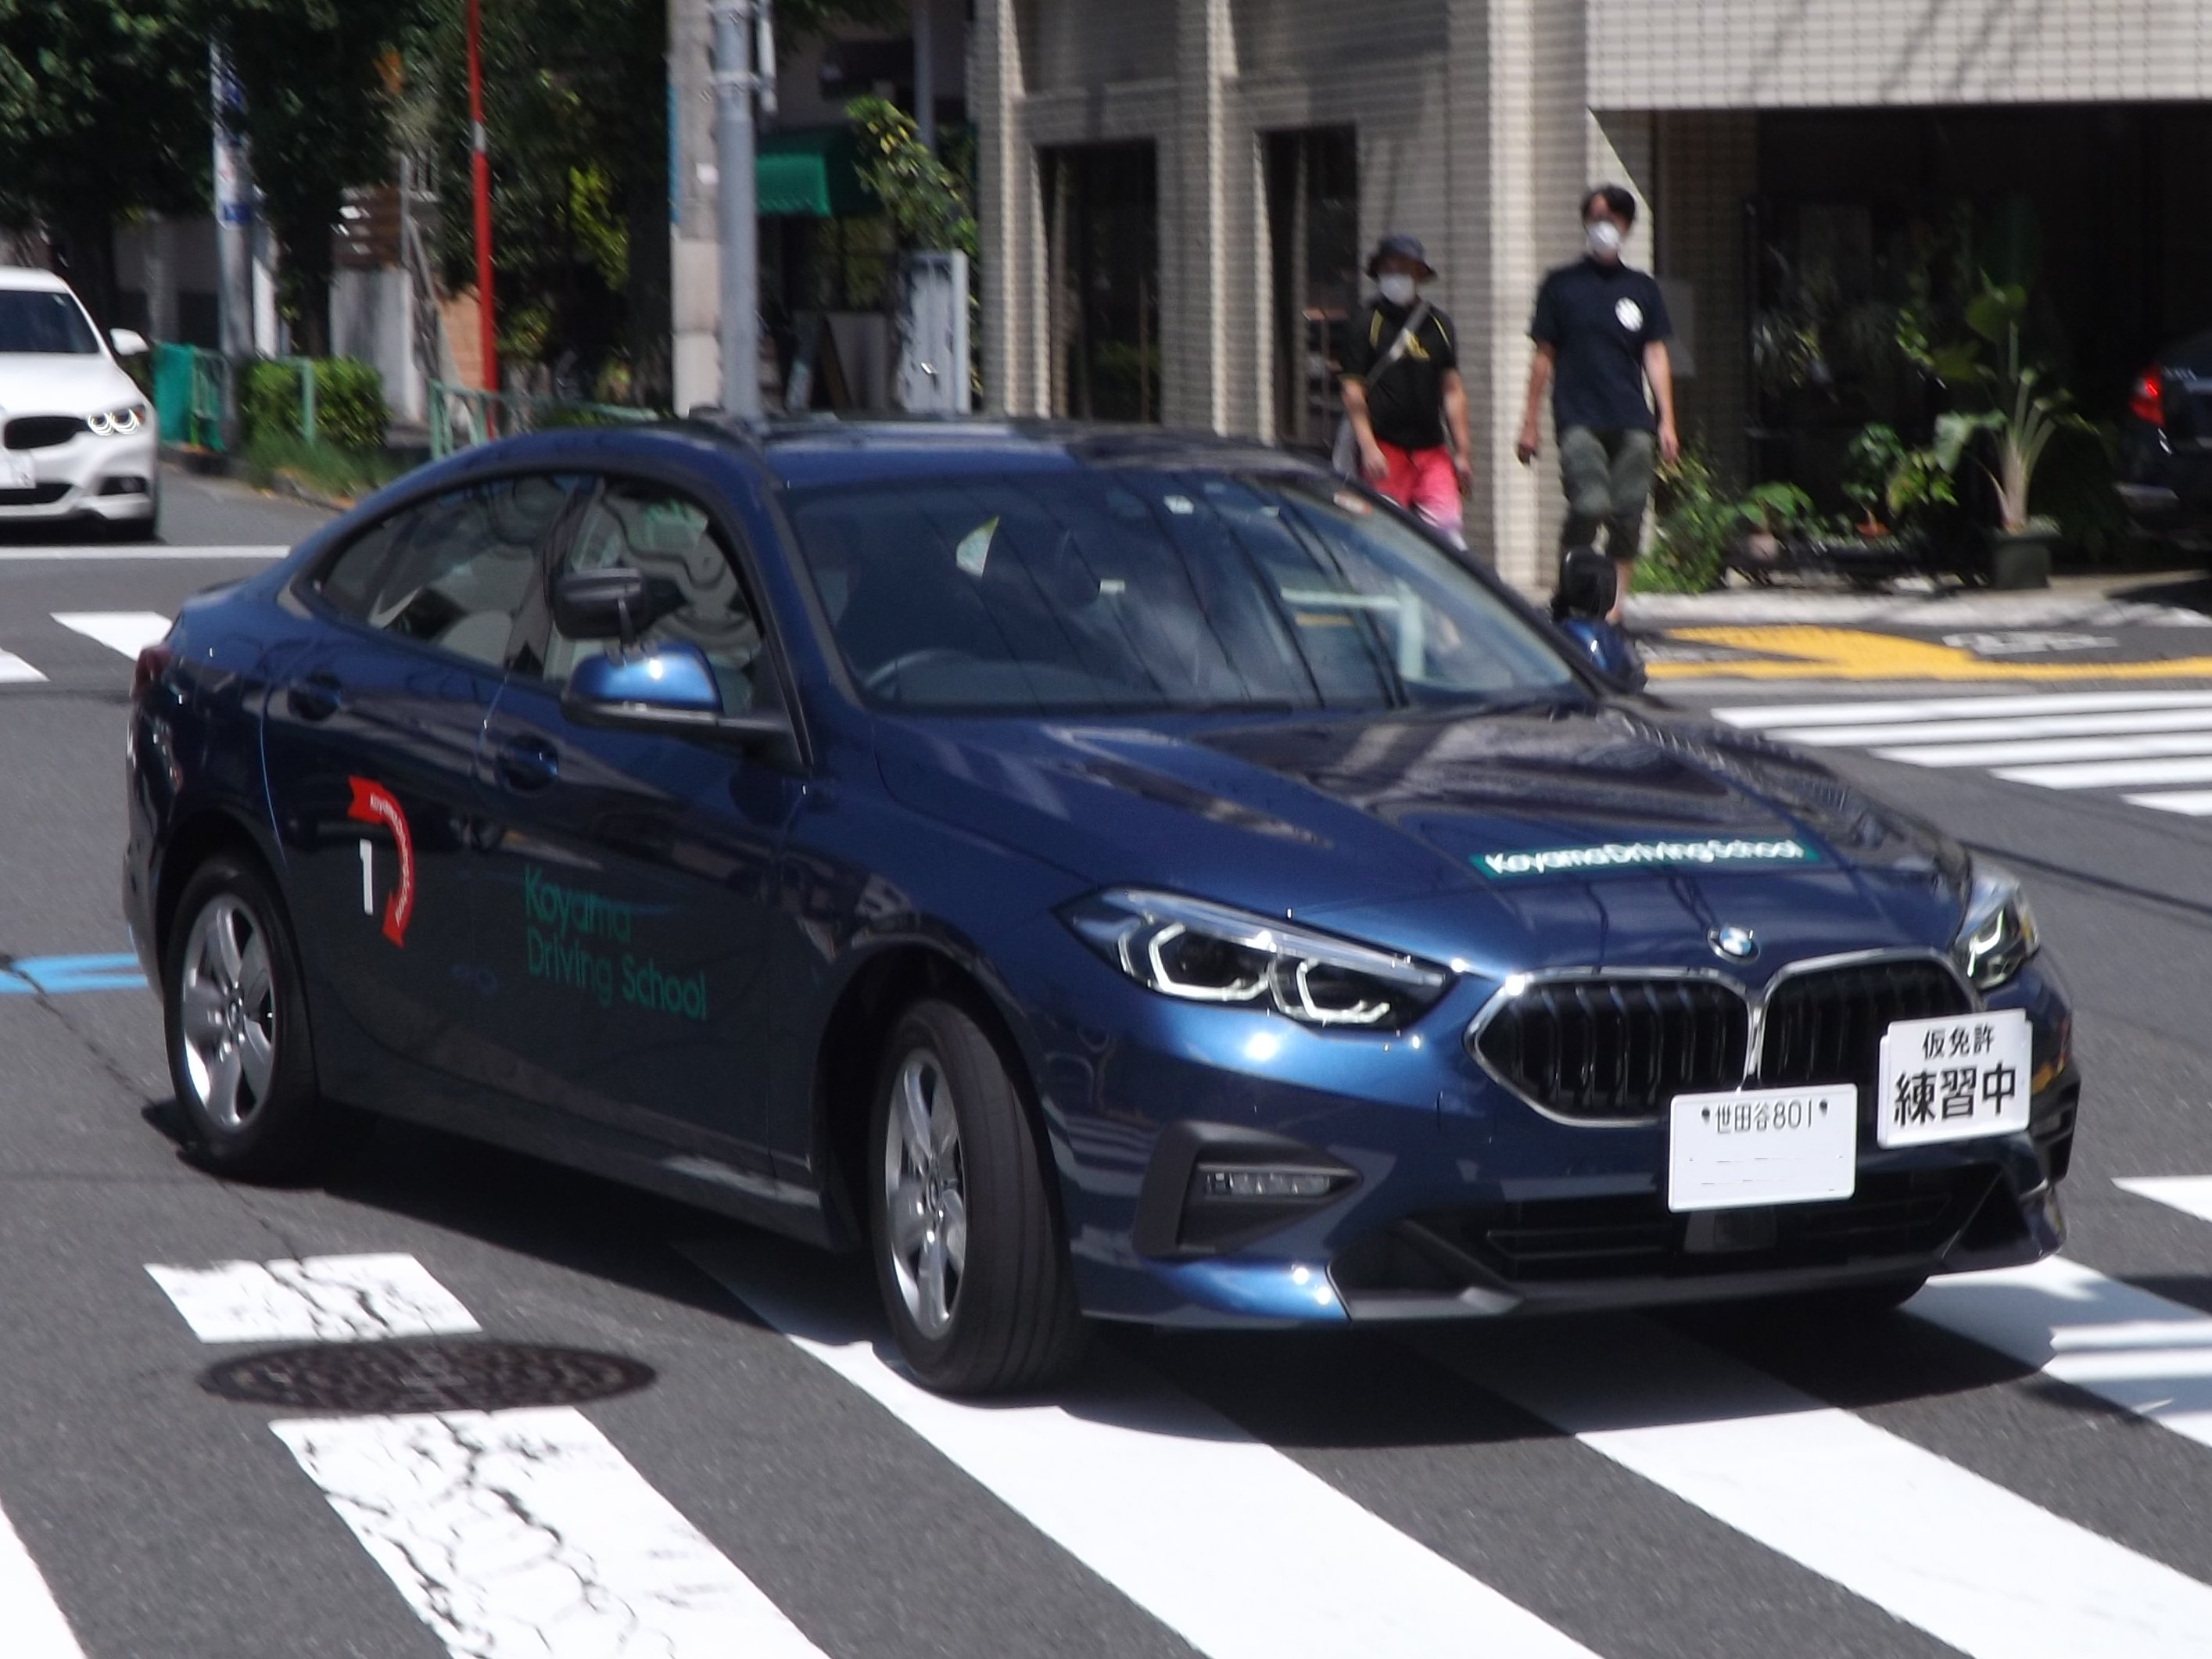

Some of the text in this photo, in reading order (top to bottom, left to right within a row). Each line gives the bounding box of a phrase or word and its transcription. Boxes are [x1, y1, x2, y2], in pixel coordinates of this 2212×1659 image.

[525, 863, 632, 943] Koyama
[527, 926, 707, 1021] Driving School
[1922, 1023, 1995, 1059] 仮免許
[1894, 1060, 2017, 1127] 練習中
